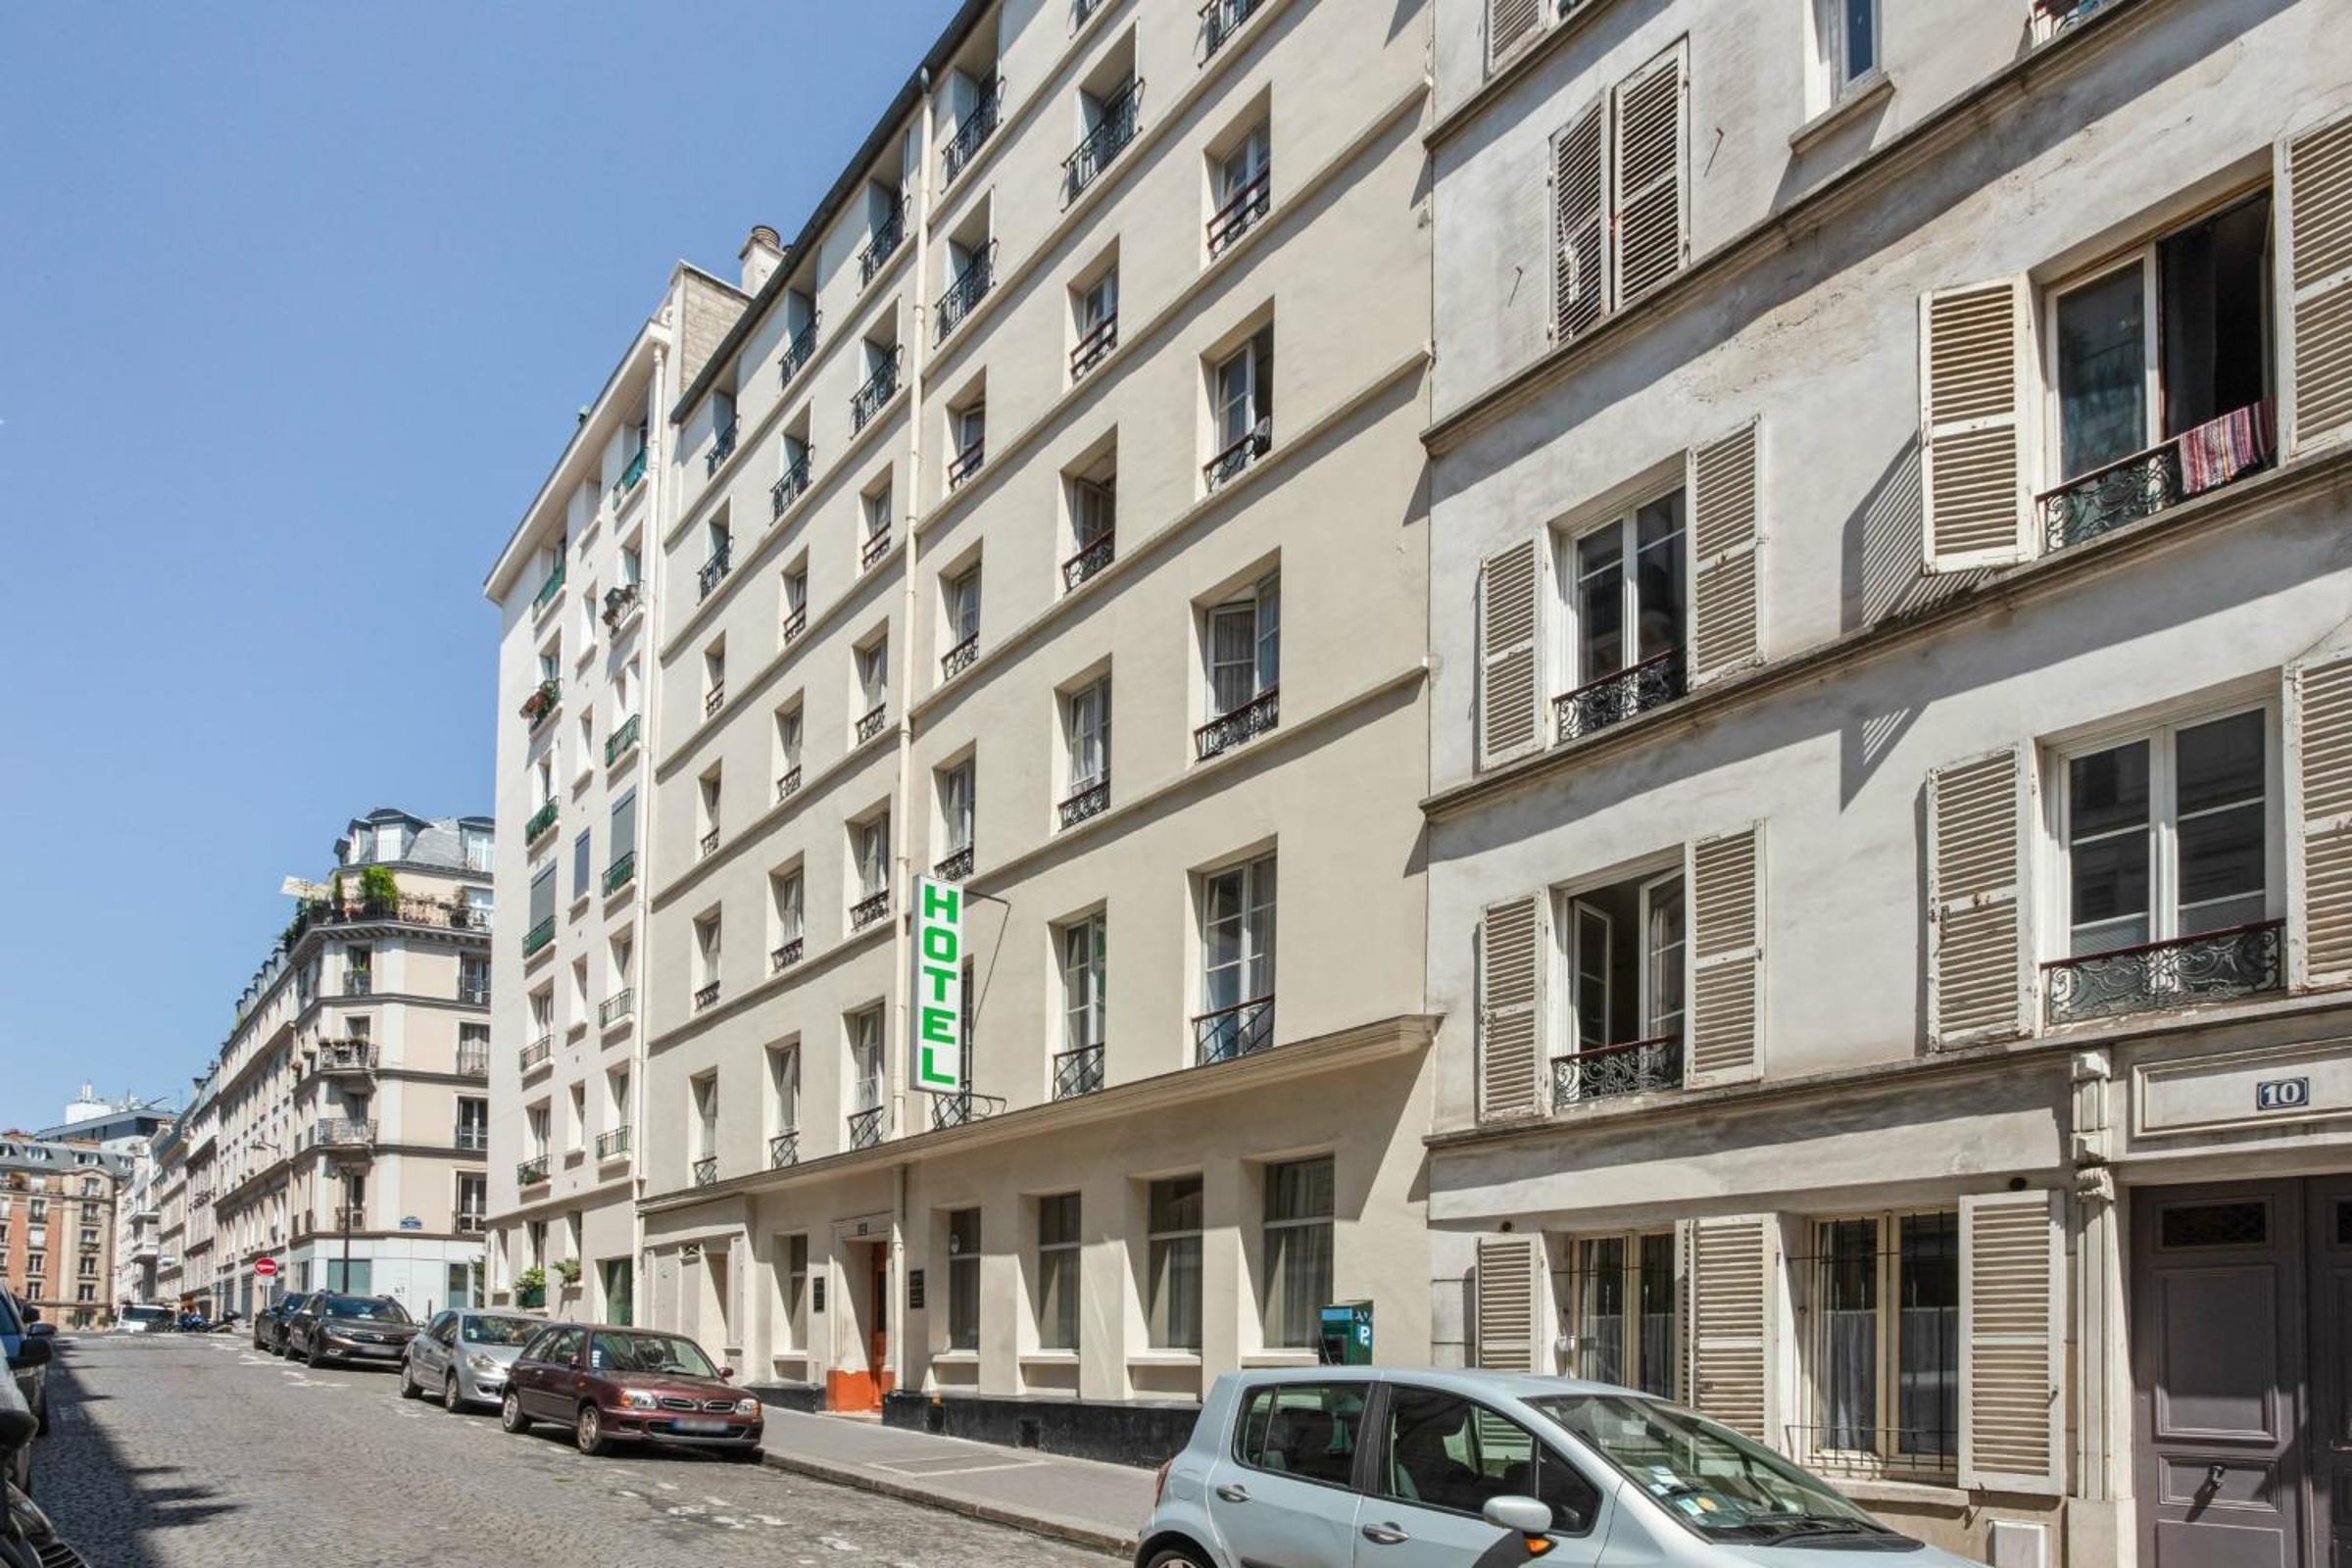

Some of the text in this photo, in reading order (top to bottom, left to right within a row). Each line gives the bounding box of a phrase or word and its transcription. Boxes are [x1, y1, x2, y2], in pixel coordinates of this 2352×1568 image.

[922, 884, 957, 1085] HOTEL
[2265, 1083, 2301, 1104] 10
[1360, 1325, 1370, 1345] P
